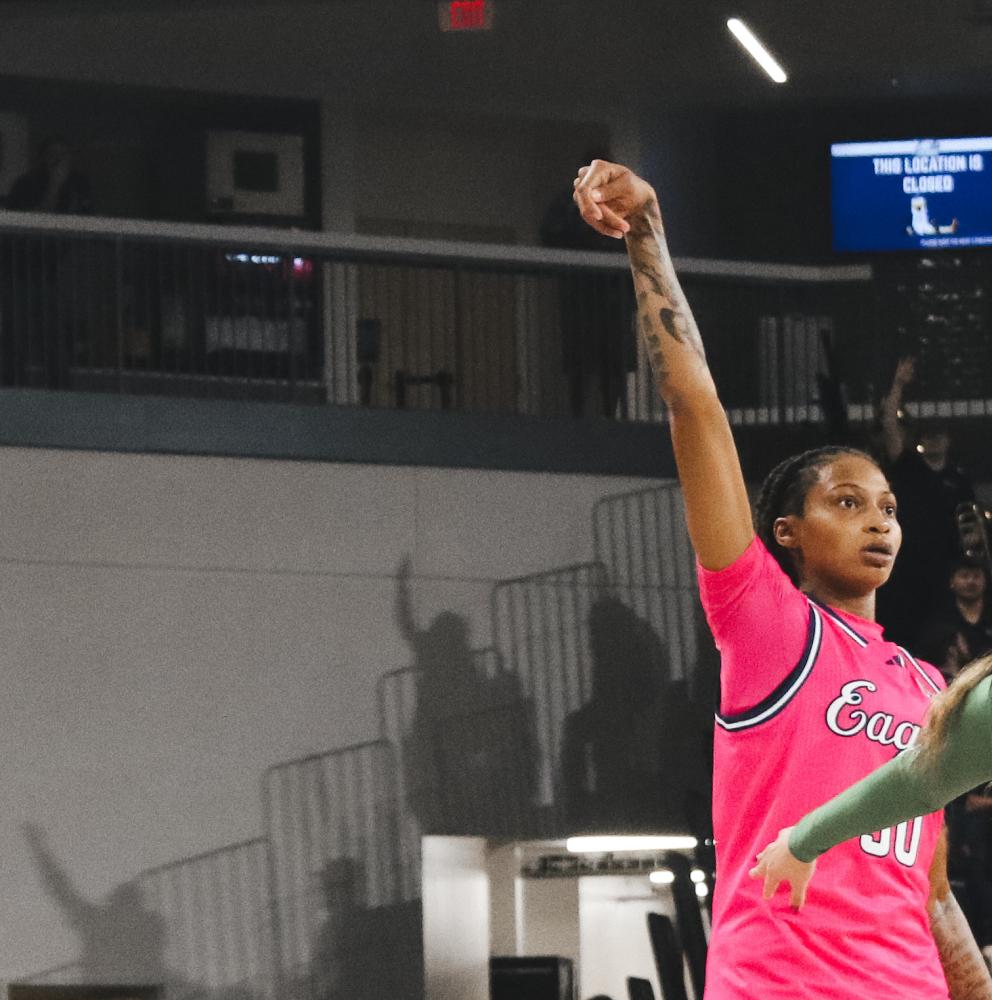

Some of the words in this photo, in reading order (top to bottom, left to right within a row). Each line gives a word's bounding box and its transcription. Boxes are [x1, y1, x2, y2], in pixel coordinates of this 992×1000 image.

[873, 157, 901, 175] THIS
[904, 154, 966, 174] LOCATION
[968, 154, 984, 172] IS
[903, 175, 955, 194] CLOSED
